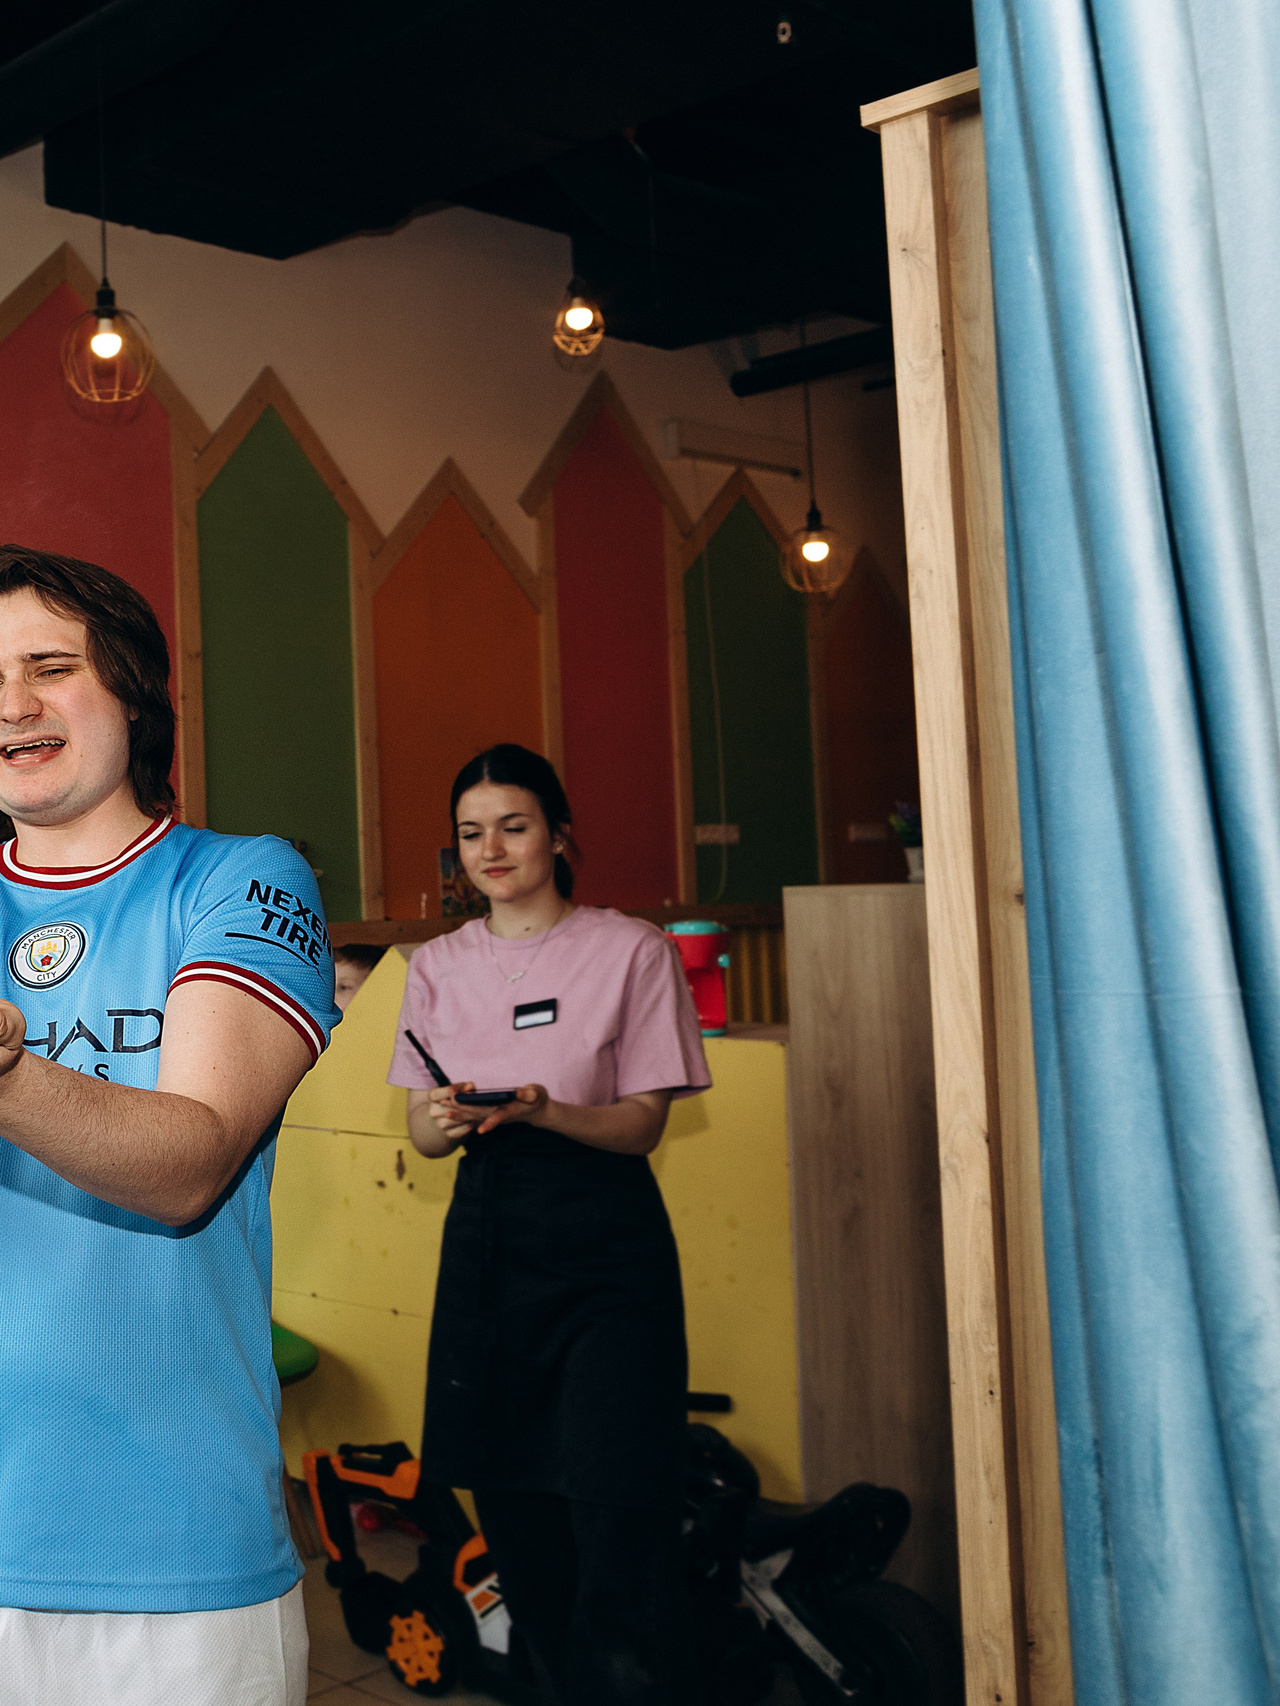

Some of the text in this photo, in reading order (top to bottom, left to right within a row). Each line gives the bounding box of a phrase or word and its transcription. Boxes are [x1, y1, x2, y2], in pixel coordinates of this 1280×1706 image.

[21, 927, 76, 950] MANCHESTER
[246, 879, 332, 957] NEXEN
[261, 907, 323, 966] TIRE
[36, 971, 57, 982] CITY
[23, 1008, 165, 1062] HAD
